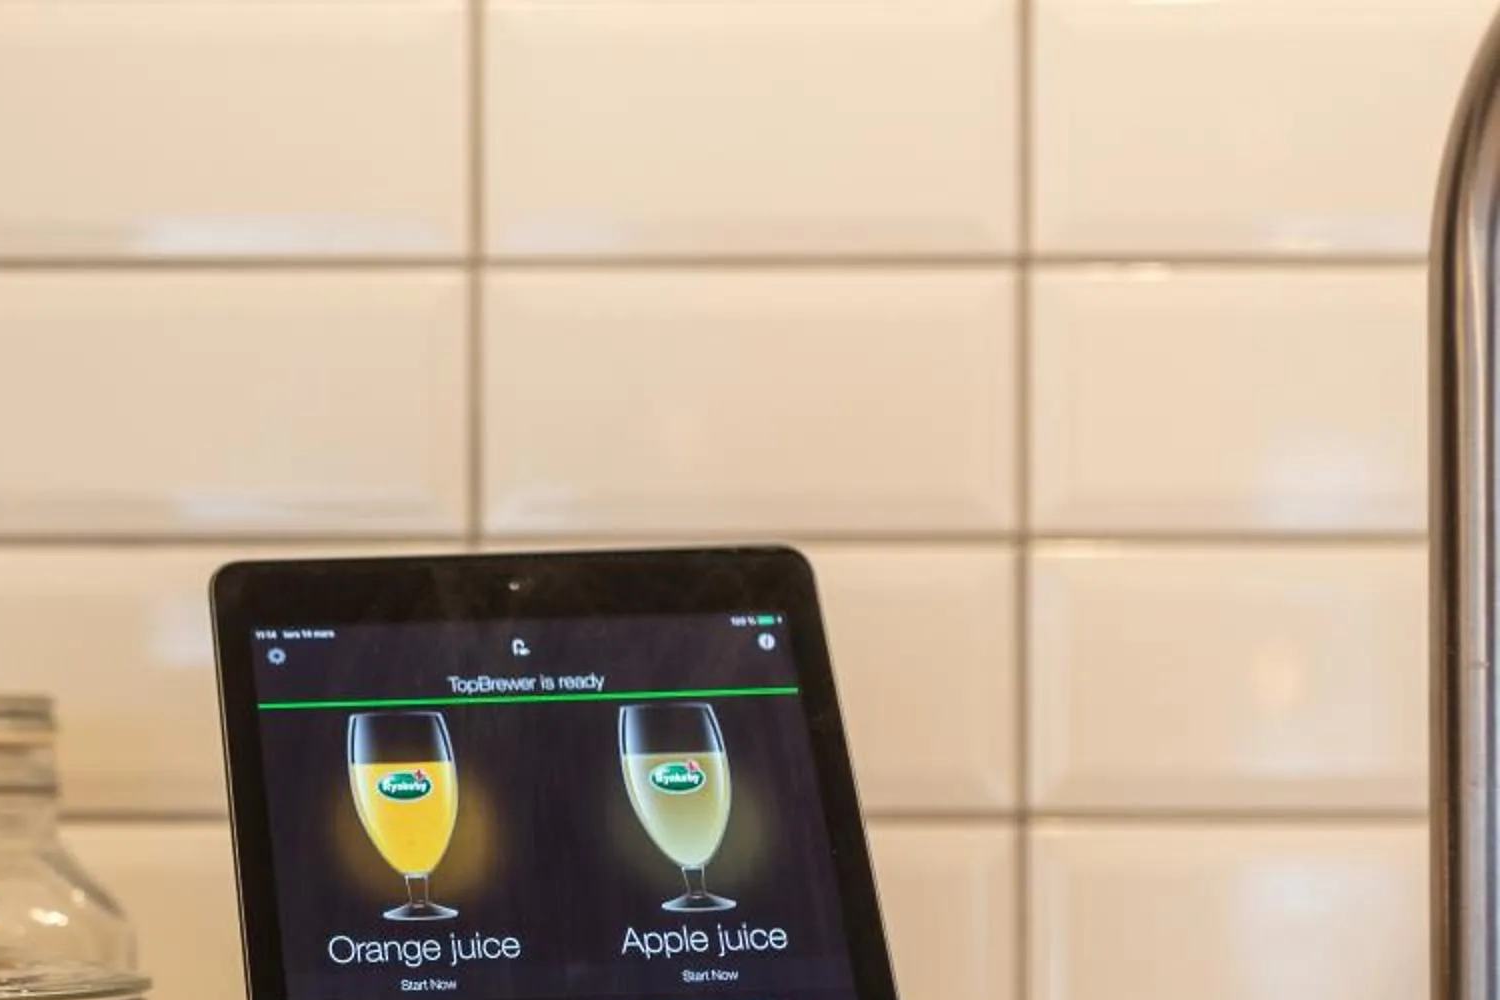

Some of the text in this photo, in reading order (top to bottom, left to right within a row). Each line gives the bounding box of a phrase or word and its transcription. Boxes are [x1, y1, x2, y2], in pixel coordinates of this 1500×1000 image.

[447, 671, 604, 694] TopBrewer is ready
[328, 931, 521, 967] Orange juice
[621, 922, 788, 959] Apple juice
[401, 978, 457, 991] Start Now
[682, 969, 739, 982] Start Now
